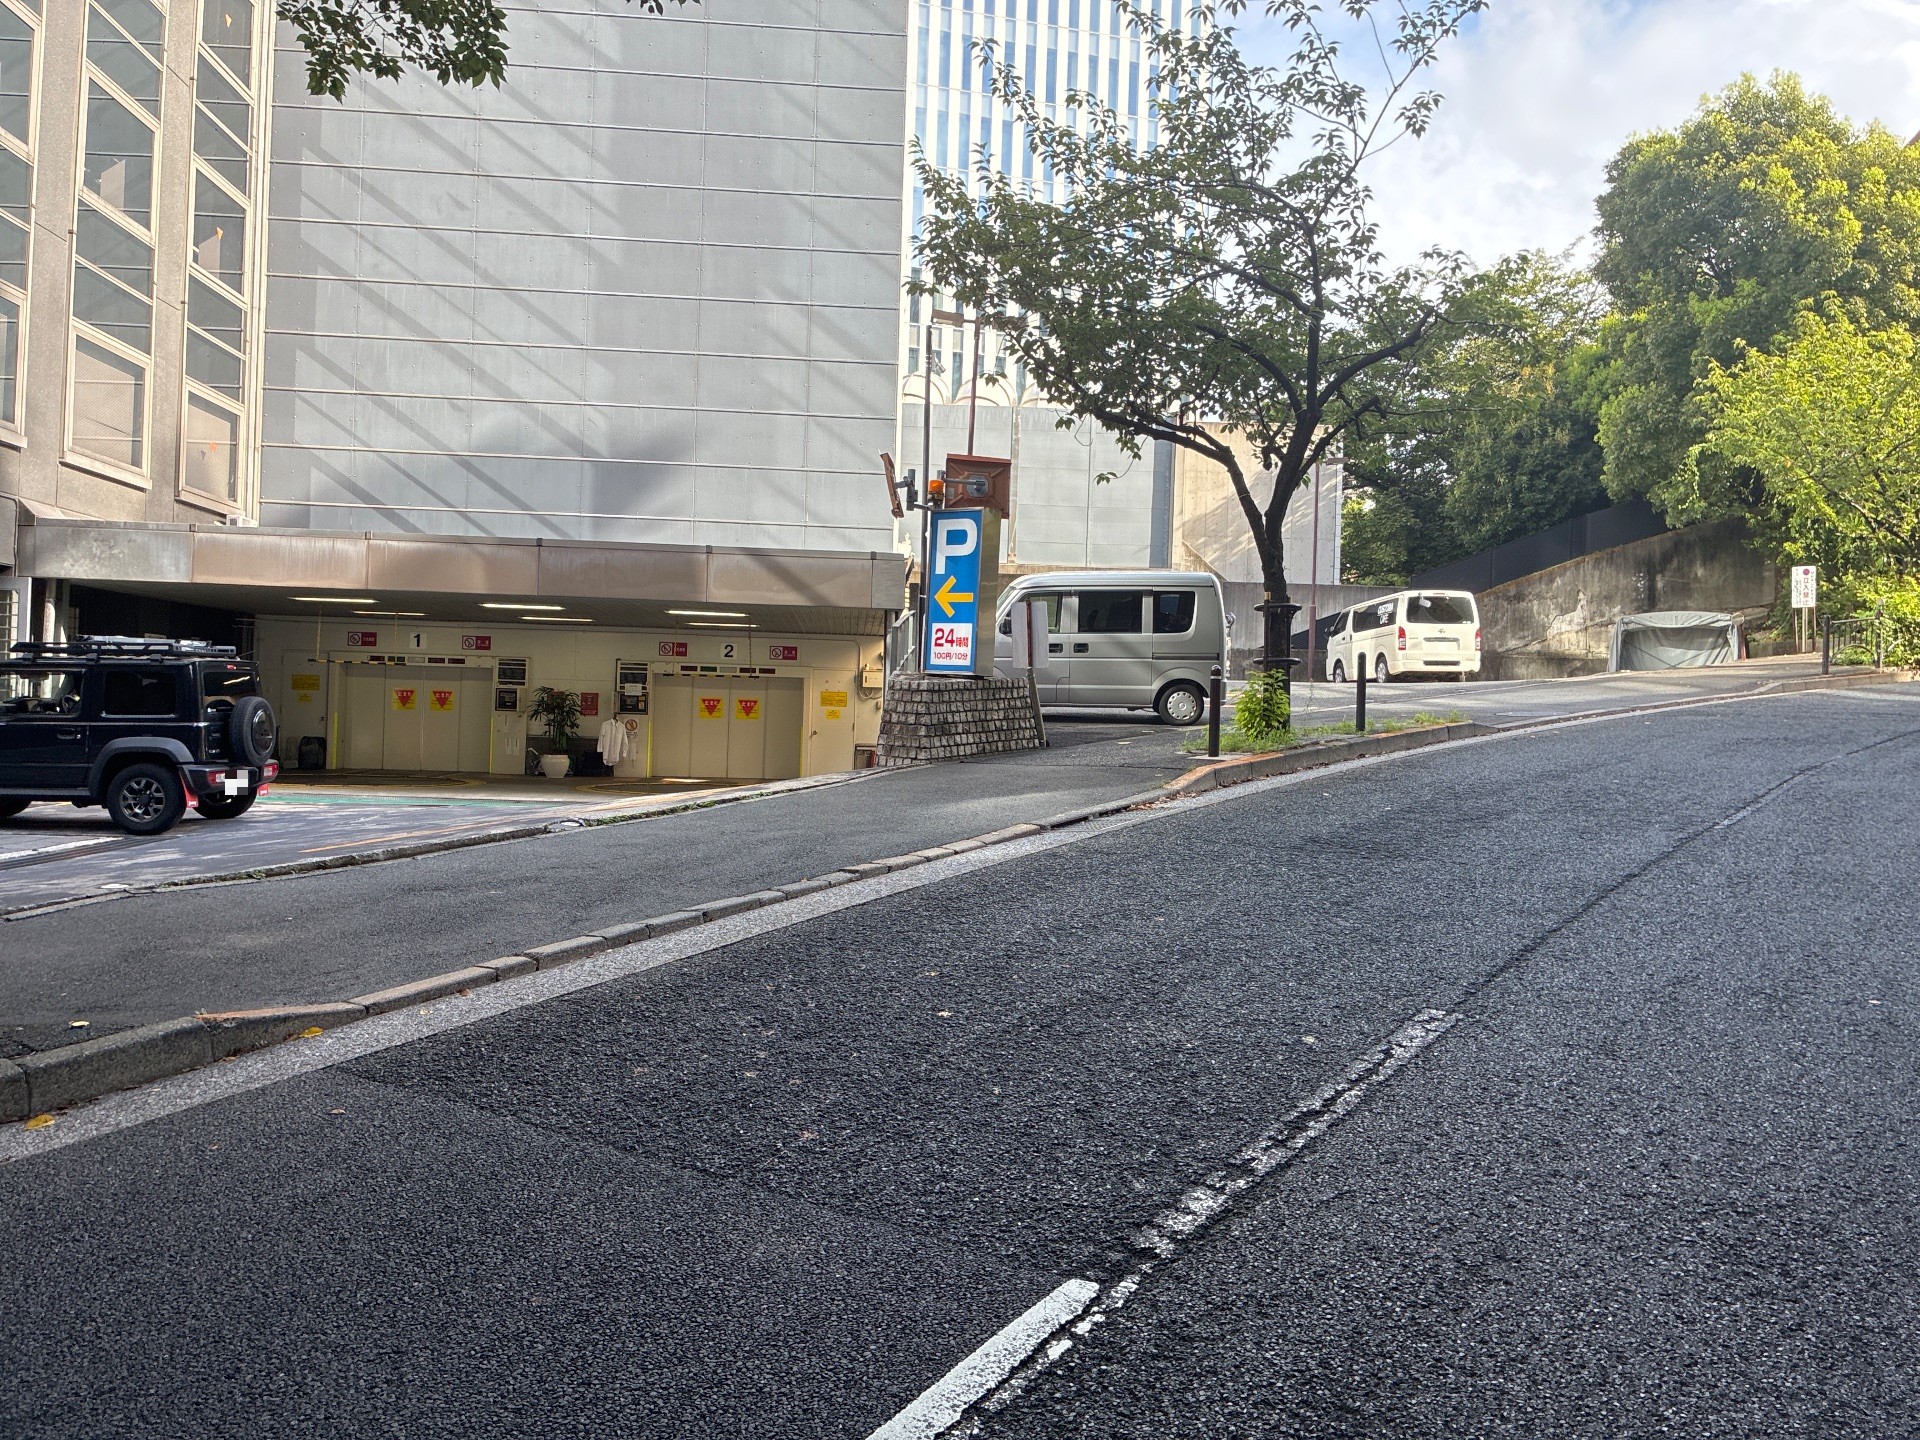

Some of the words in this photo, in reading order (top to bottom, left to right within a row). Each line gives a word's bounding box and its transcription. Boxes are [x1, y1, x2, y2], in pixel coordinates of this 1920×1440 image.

[935, 518, 978, 574] P
[413, 633, 421, 648] 1
[934, 628, 969, 648] 24時間
[724, 644, 734, 658] 2
[933, 652, 968, 660] 100円/10分
